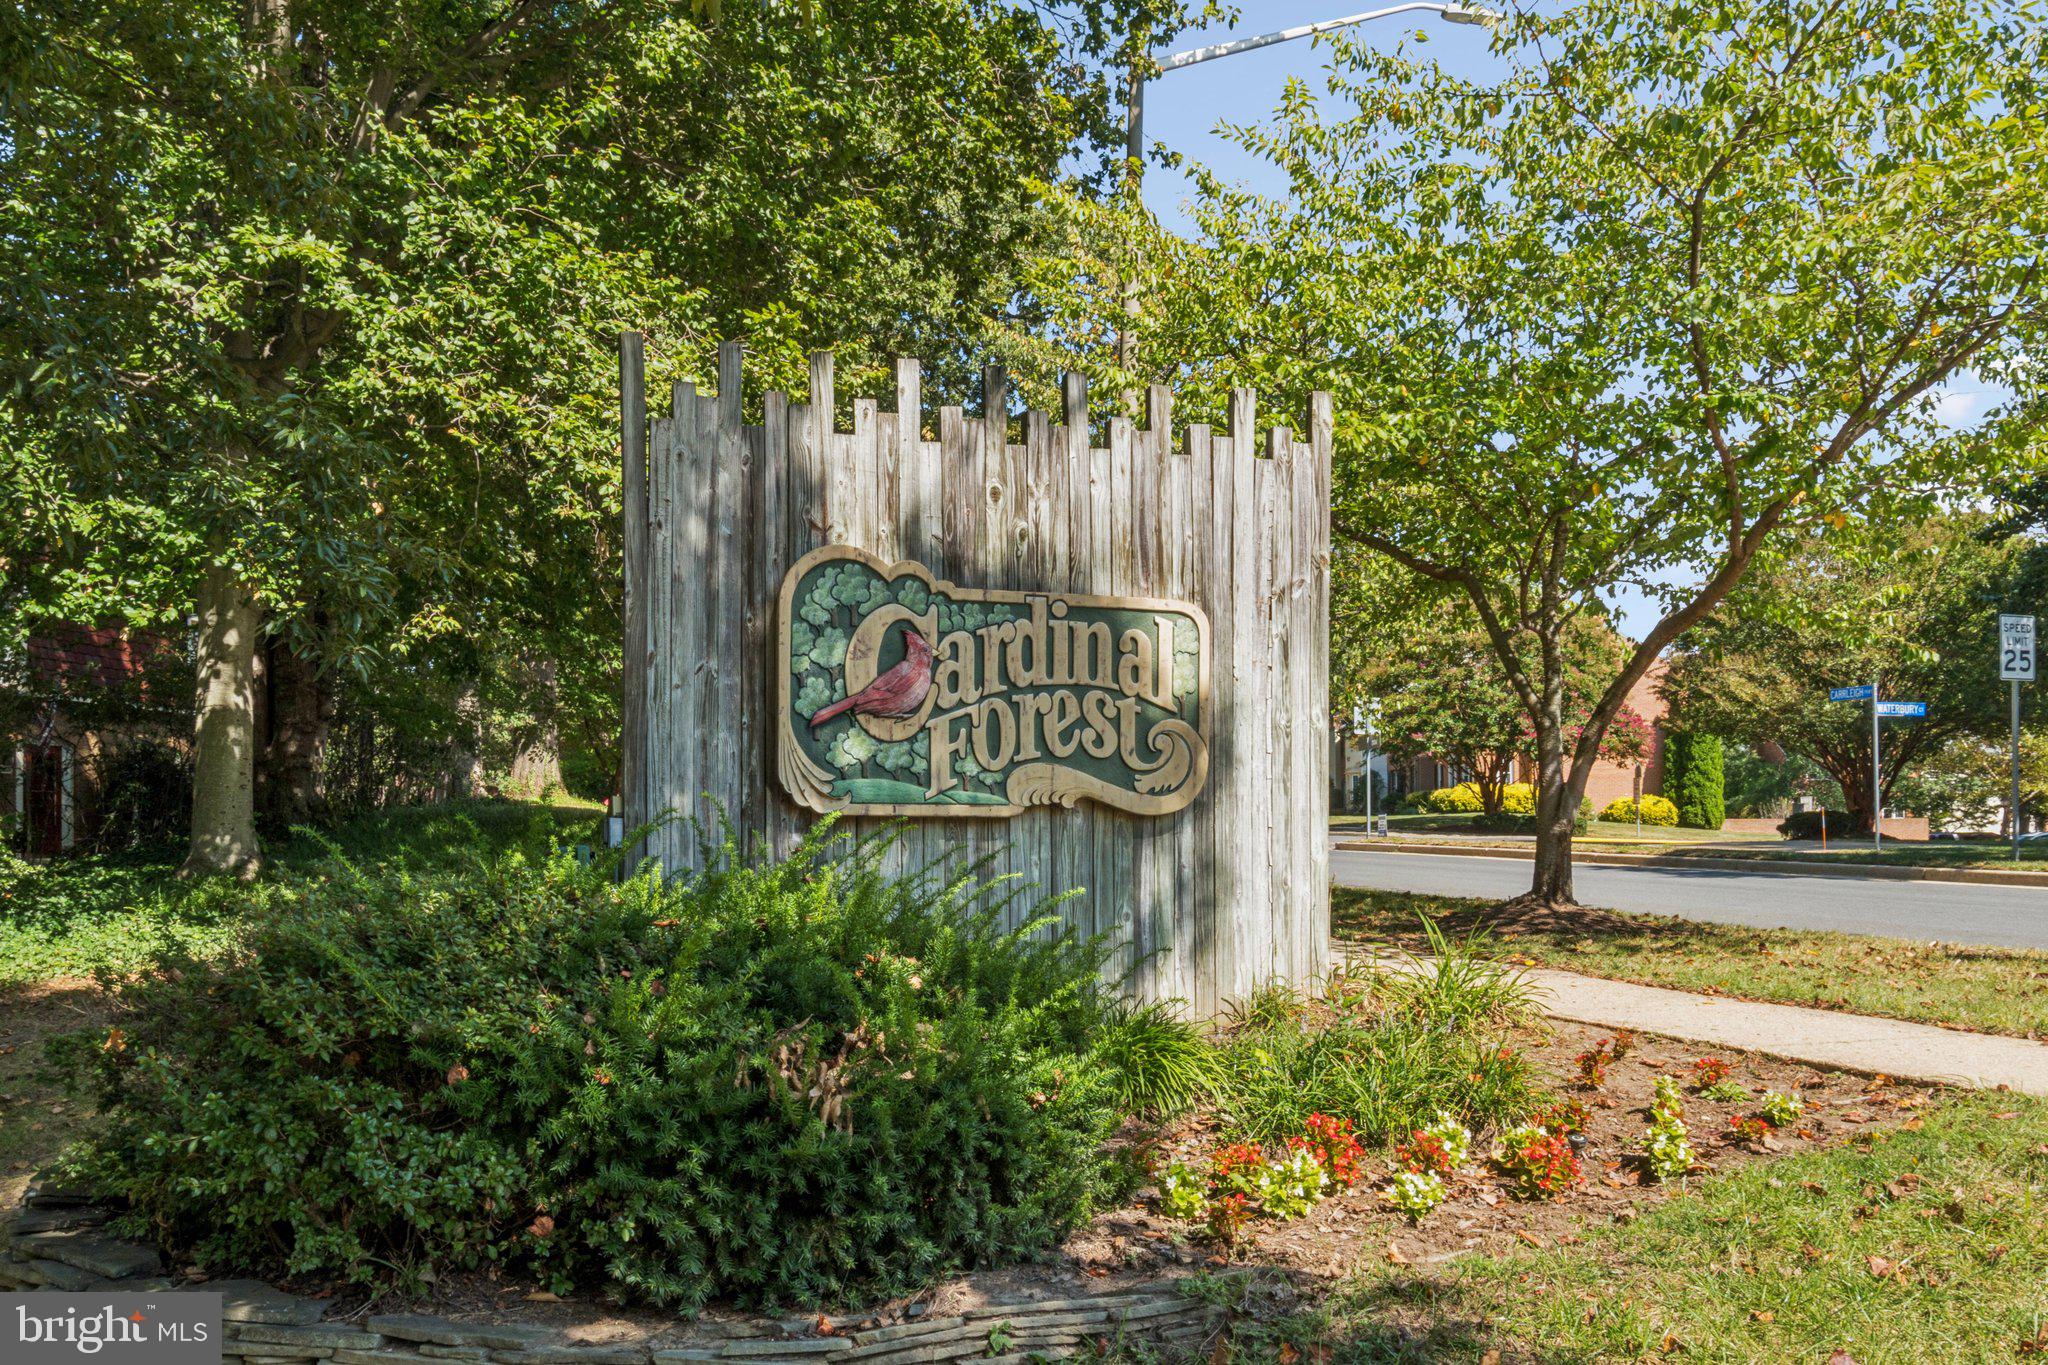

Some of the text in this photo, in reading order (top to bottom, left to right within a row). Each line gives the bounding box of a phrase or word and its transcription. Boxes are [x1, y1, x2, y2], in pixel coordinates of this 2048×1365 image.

[2003, 622, 2032, 634] SPEED
[2006, 636, 2030, 647] LIMIT
[844, 595, 1178, 742] Cardinal
[2003, 649, 2031, 672] 25
[1876, 703, 1918, 714] WATERBURY
[924, 688, 1174, 799] Forest
